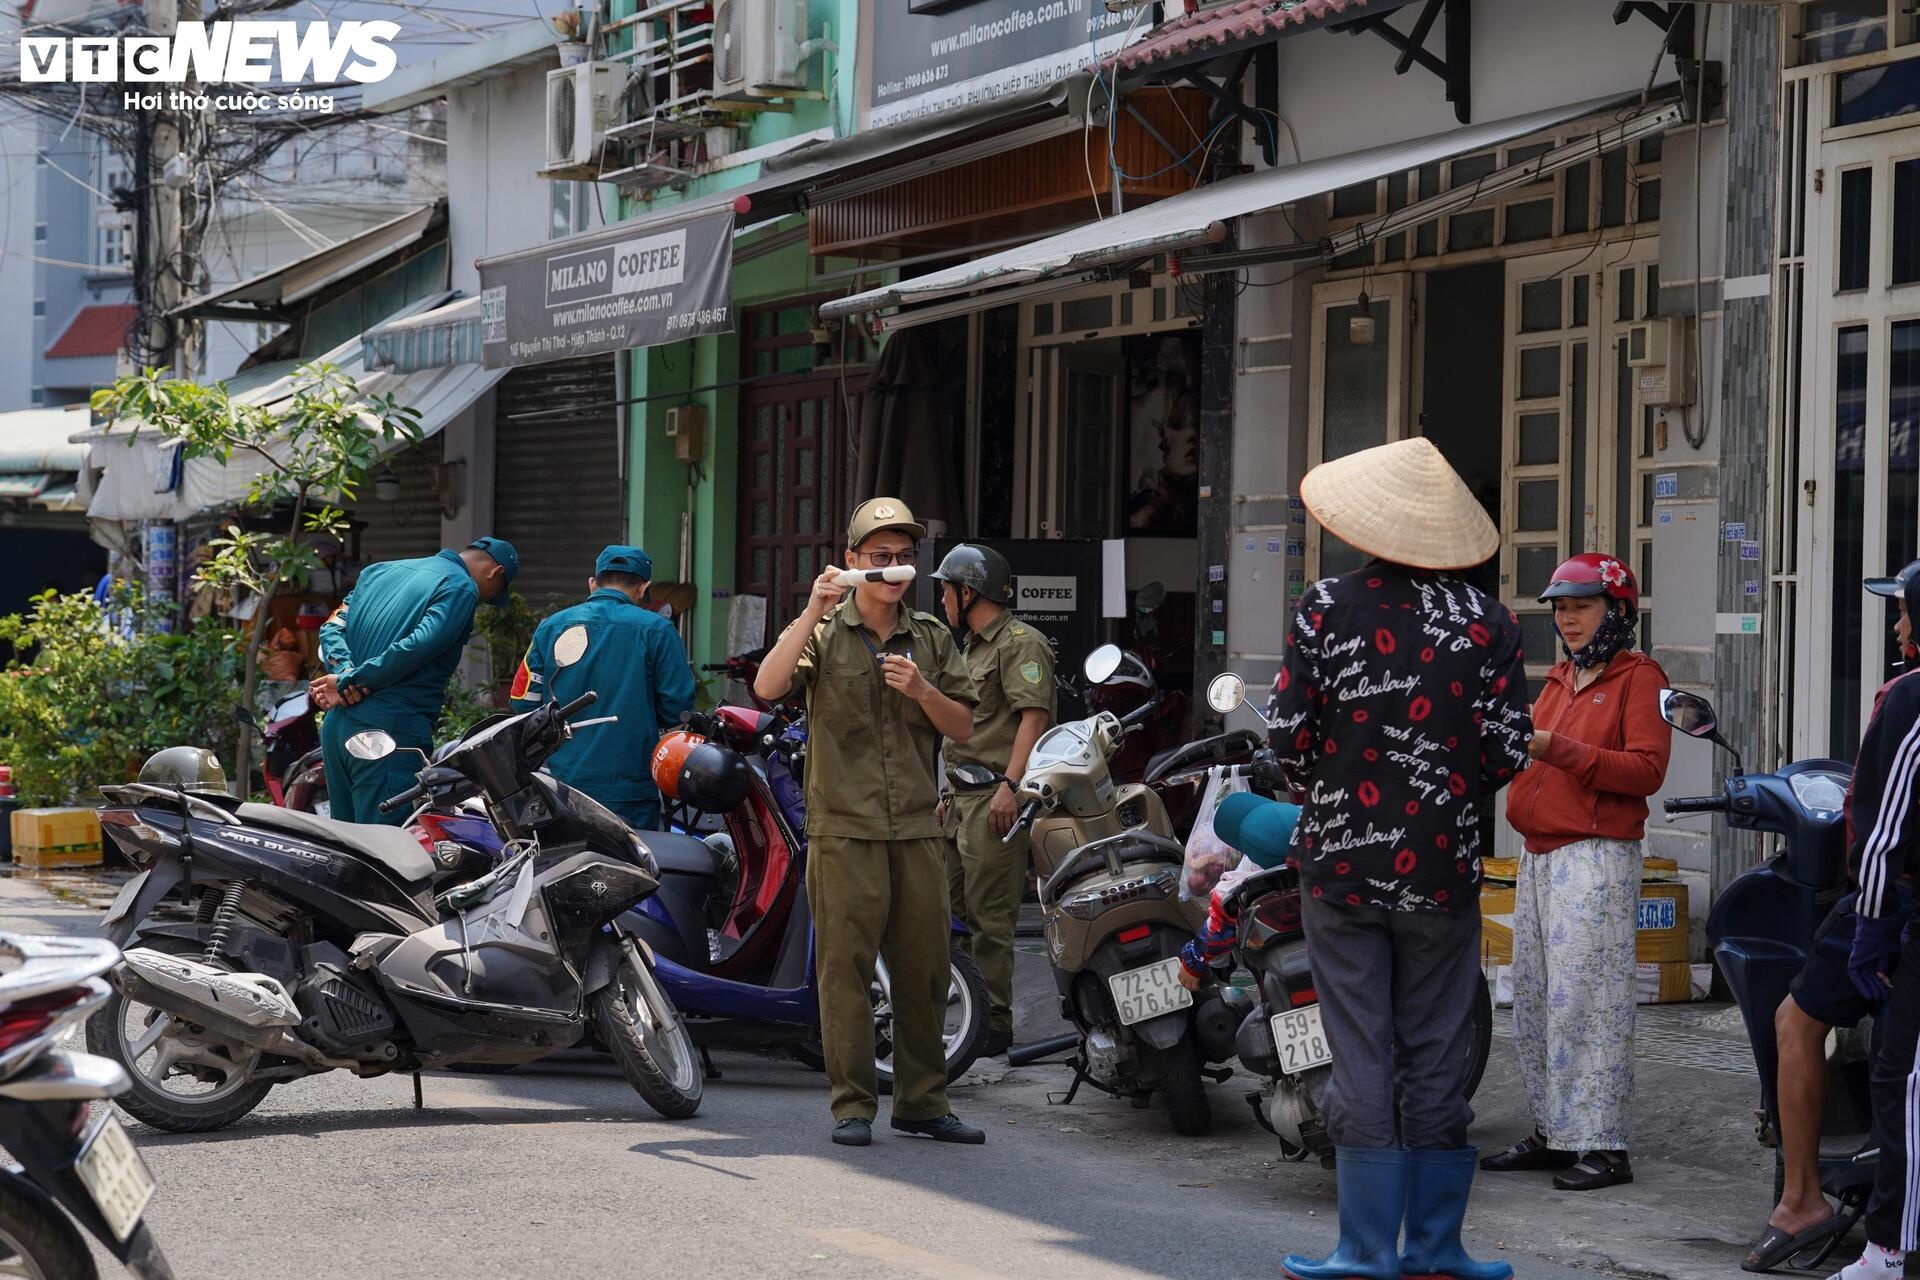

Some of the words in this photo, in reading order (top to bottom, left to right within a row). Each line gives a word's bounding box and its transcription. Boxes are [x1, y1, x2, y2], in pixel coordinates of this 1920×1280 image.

[931, 0, 1081, 57] www.milanocoffee.com.vn
[905, 72, 920, 89] 1900
[921, 69, 935, 85] 636
[936, 64, 949, 80] 873
[551, 258, 607, 292] MILANO
[618, 244, 680, 278] COFFEE
[553, 292, 673, 327] www.milanocoffee.com.vn
[697, 309, 711, 324] 486
[712, 307, 727, 322] 467
[610, 325, 625, 340] Q.12
[1021, 587, 1073, 599] COFFEE
[220, 831, 260, 846] AIR
[264, 840, 329, 861] BLADE
[1121, 964, 1172, 997] 72-C1
[1121, 984, 1191, 1021] 676.42
